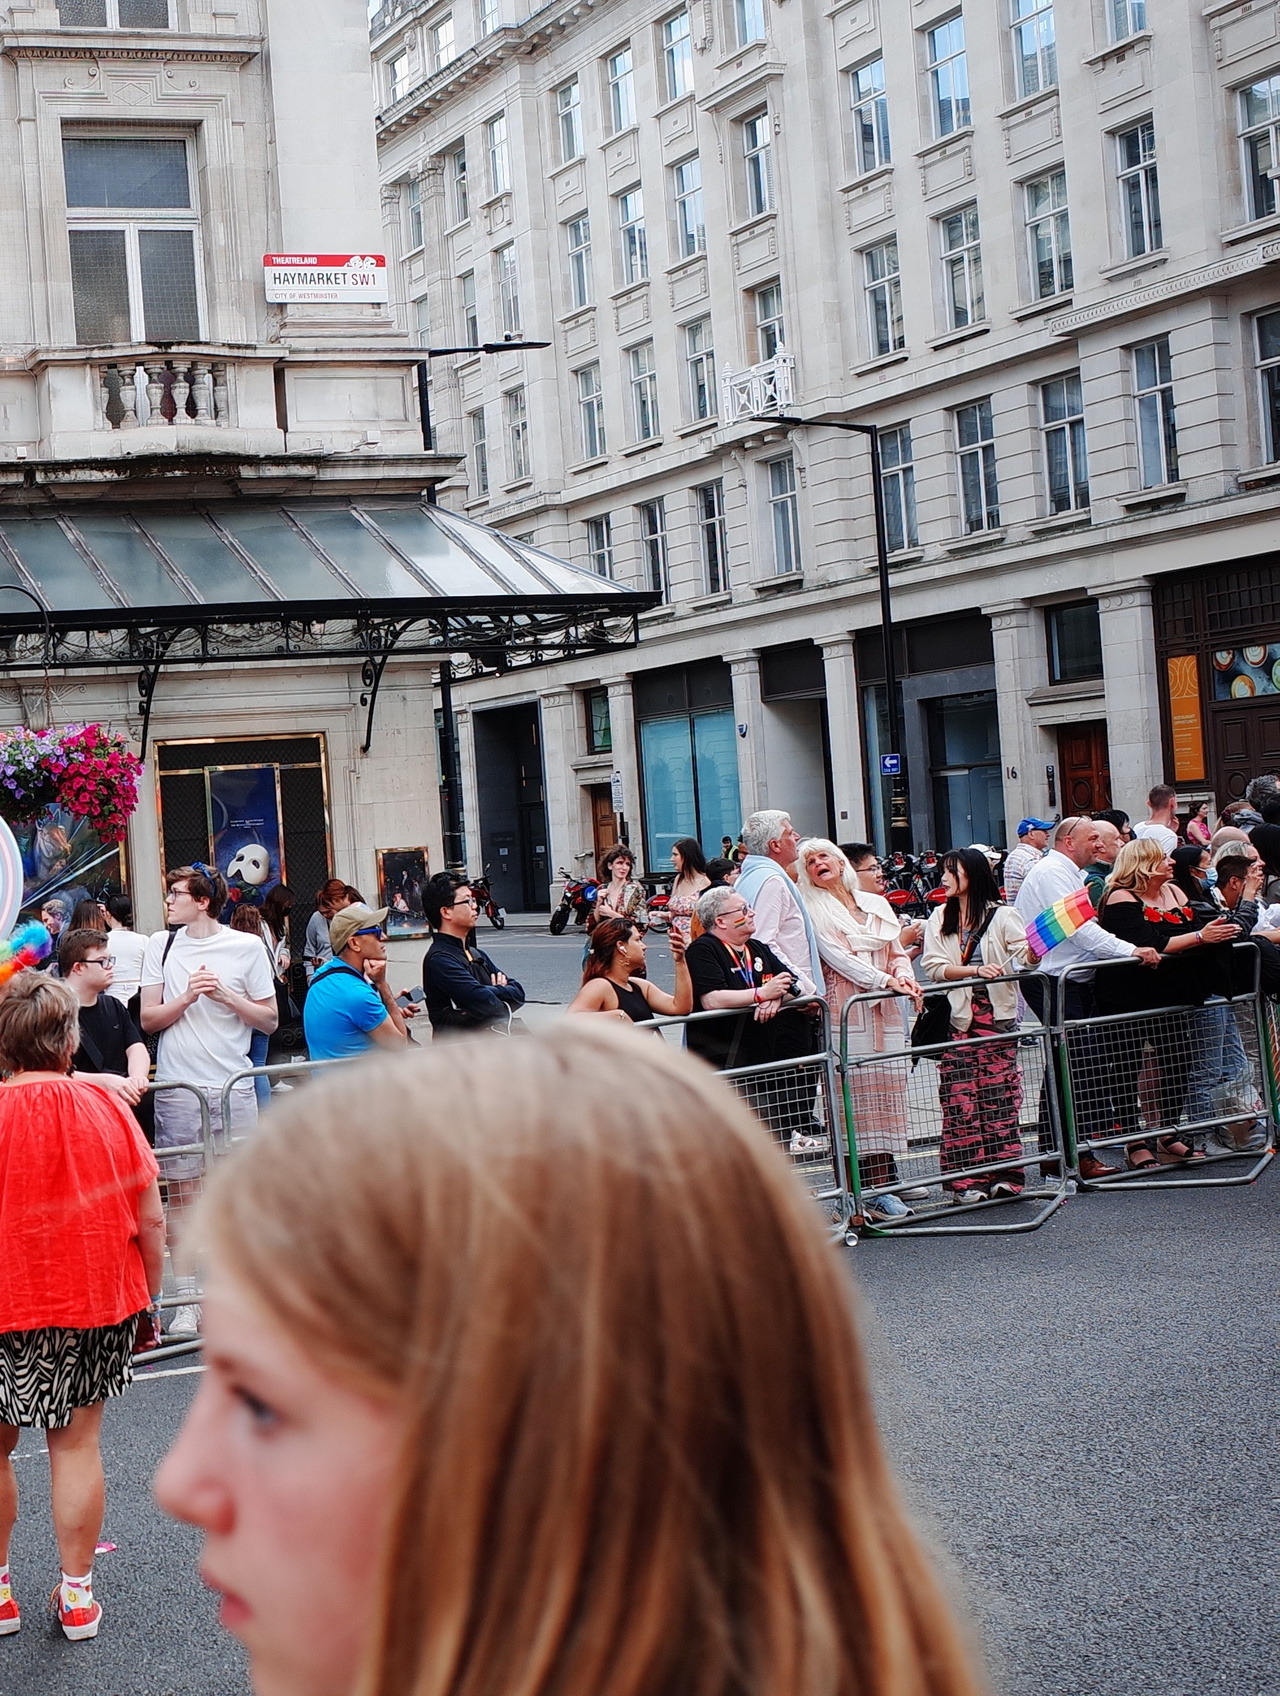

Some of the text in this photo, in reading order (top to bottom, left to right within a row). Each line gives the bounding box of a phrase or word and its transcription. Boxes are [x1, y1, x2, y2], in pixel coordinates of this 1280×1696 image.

[271, 256, 318, 265] THEATRELAND
[273, 272, 376, 286] HAYMARKET SW1
[274, 292, 288, 300] CITY
[1006, 766, 1018, 780] 16
